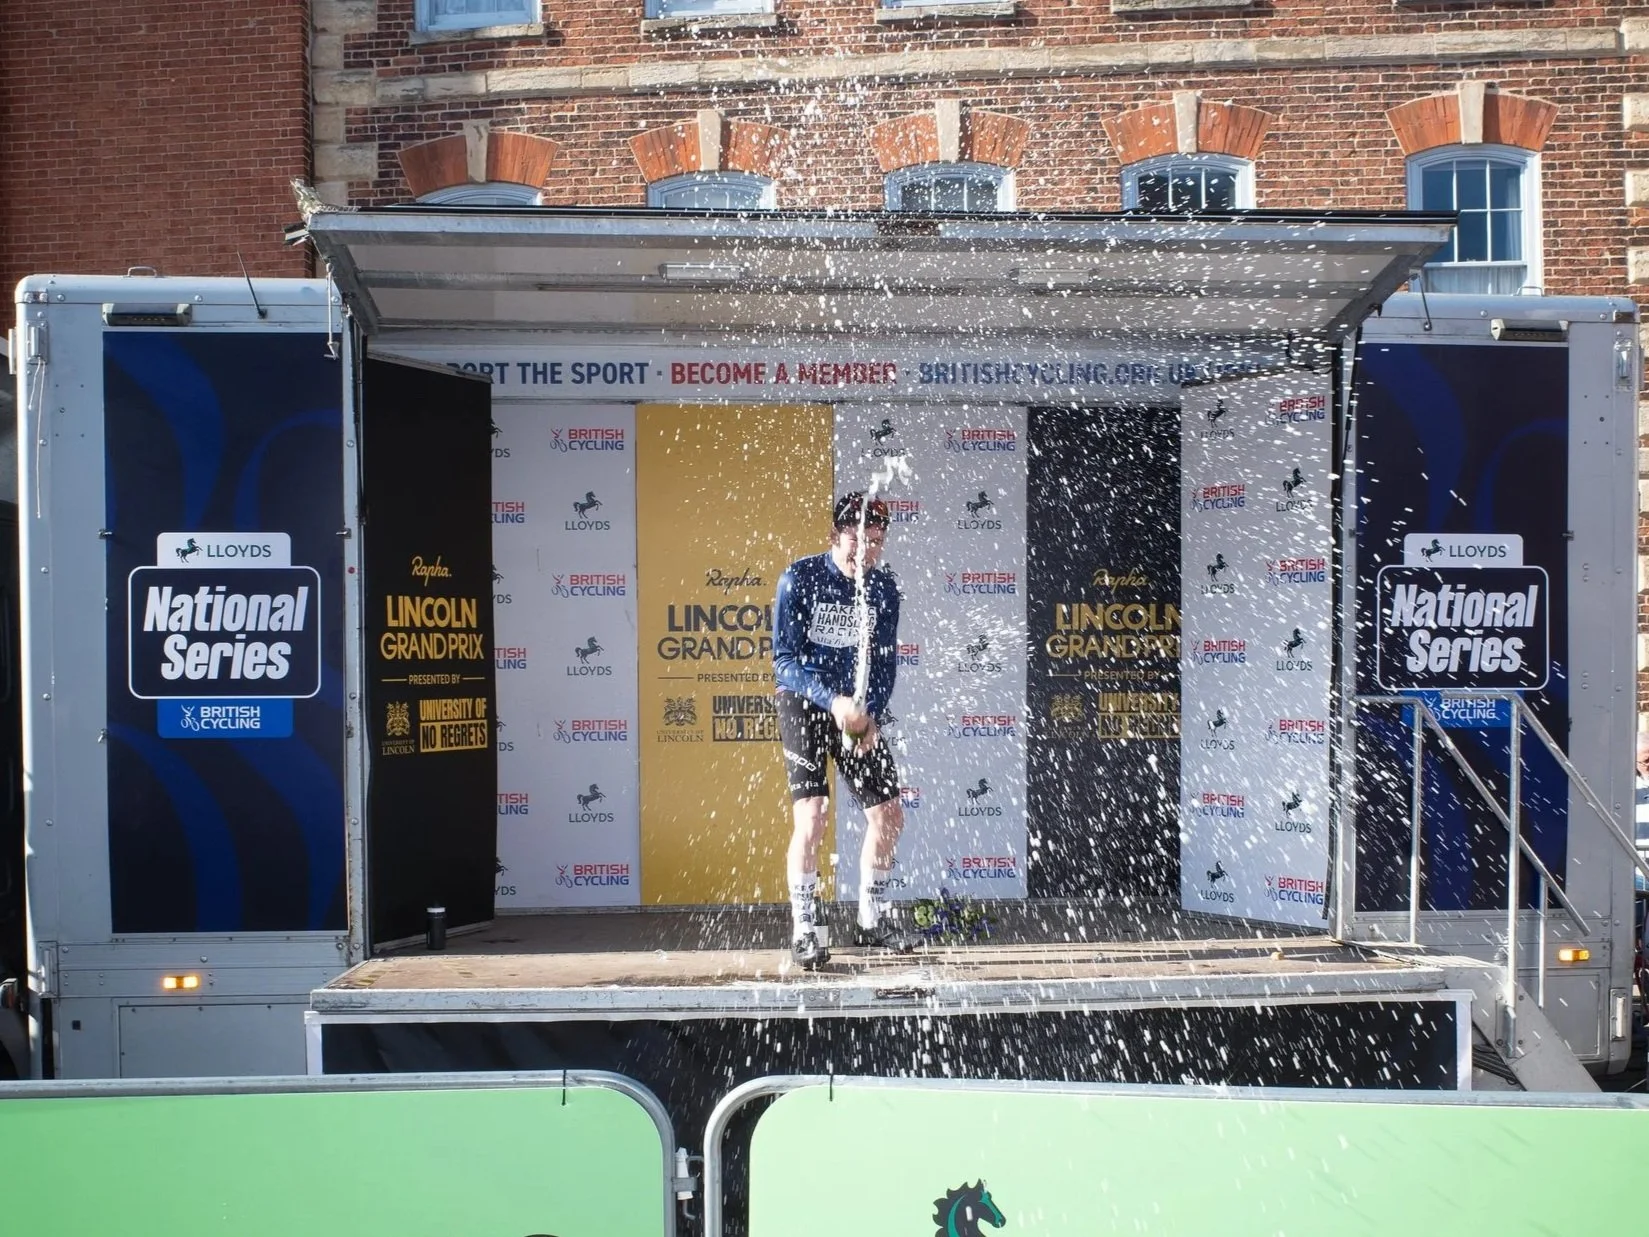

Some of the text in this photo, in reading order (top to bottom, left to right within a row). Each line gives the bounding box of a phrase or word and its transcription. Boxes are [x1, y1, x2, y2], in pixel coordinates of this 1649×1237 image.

[517, 362, 562, 385] THE
[571, 362, 650, 385] SPORT
[671, 362, 767, 385] BECOME
[773, 362, 790, 385] A
[798, 362, 898, 385] MEMBER
[568, 428, 624, 439] BRITISH
[962, 430, 1016, 440] BRITISH
[568, 439, 624, 451] CYCLING
[962, 440, 1016, 451] CYCLING
[1203, 484, 1245, 498] BRITISH
[492, 502, 525, 512] TISH
[887, 501, 919, 511] TISH
[1203, 496, 1245, 510] CYCLING
[493, 513, 525, 523] LING
[565, 521, 610, 531] LLOYDS
[957, 520, 1002, 530] LLOYDS
[207, 545, 272, 558] LLOYDS
[1449, 545, 1506, 558] LLOYDS
[1279, 557, 1325, 572] BRITISH
[570, 574, 626, 585] BRITISH
[962, 573, 1016, 583] BRITISH
[1279, 570, 1325, 584] CYCLING
[570, 585, 626, 596] CYCLING
[962, 583, 1016, 594] CYCLING
[143, 586, 309, 632] National
[1391, 583, 1539, 628] National
[386, 595, 478, 629] LINCOLN
[667, 604, 774, 632] LINCOL
[380, 632, 484, 660] GRAND PRIX
[657, 636, 750, 661] GRAND
[1045, 633, 1138, 658] GRAND
[1203, 640, 1246, 652] BRITISH
[1406, 628, 1524, 673] Series
[160, 633, 292, 681] Series
[495, 647, 527, 658] TISH
[1203, 651, 1246, 664] CYCLING
[496, 659, 527, 669] LING
[567, 666, 612, 676] LLOYDS
[1084, 670, 1161, 680] PRESENTED BY
[408, 673, 461, 685] PRESENTED BY
[697, 673, 760, 683] PRESENTED
[200, 705, 261, 717] BRITISH
[420, 698, 487, 720] UNIVERSITY OF
[1441, 708, 1496, 719] CYCLING
[200, 717, 261, 730] CYCLING
[572, 719, 628, 730] BRITISH
[962, 716, 1016, 726] BRITISH
[1279, 719, 1325, 732] BRITISH
[715, 718, 738, 740] NO
[962, 726, 1016, 737] CYCLING
[422, 722, 486, 749] NO REGRETS
[572, 730, 628, 742] CYCLING
[382, 745, 415, 756] LINCOLN
[496, 793, 528, 804] TISH
[498, 804, 528, 815] LING
[958, 806, 1002, 817] LLOYDS
[568, 813, 614, 823] LLOYDS
[1275, 820, 1312, 834] LLOYDS
[963, 857, 1016, 867] BRITISH
[573, 864, 629, 875] BRITISH
[963, 868, 1016, 879] CYCLING
[573, 875, 629, 886] CYCLING
[1278, 877, 1324, 893] BRITISH
[1200, 889, 1235, 903] LLOYDS
[1278, 890, 1324, 905] CYCLING
